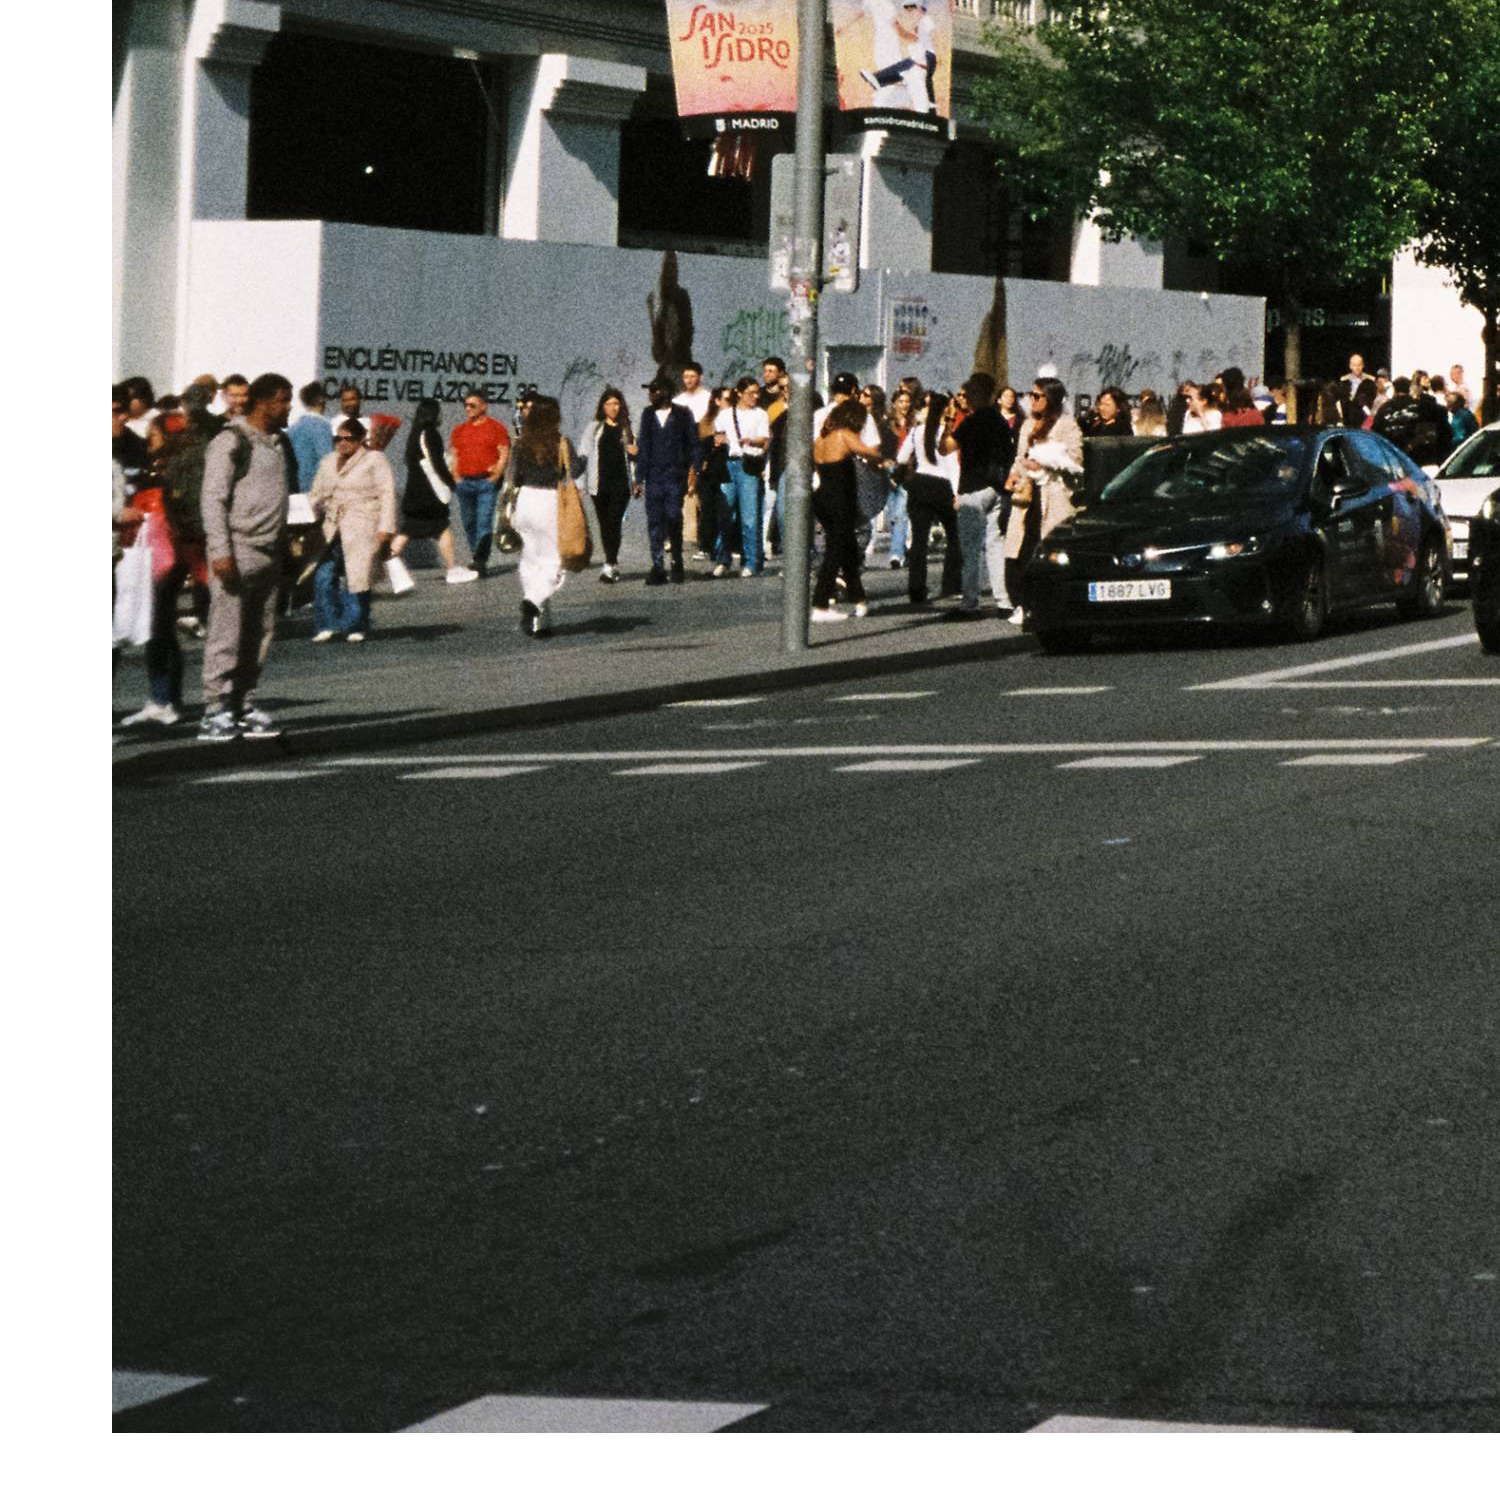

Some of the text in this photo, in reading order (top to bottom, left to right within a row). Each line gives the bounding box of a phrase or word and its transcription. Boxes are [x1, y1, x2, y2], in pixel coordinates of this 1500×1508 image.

[680, 4, 736, 41] SAN
[702, 33, 792, 70] ISIDRO
[731, 117, 780, 130] MADRID
[323, 343, 518, 376] ENCUÉNTRANOS EN
